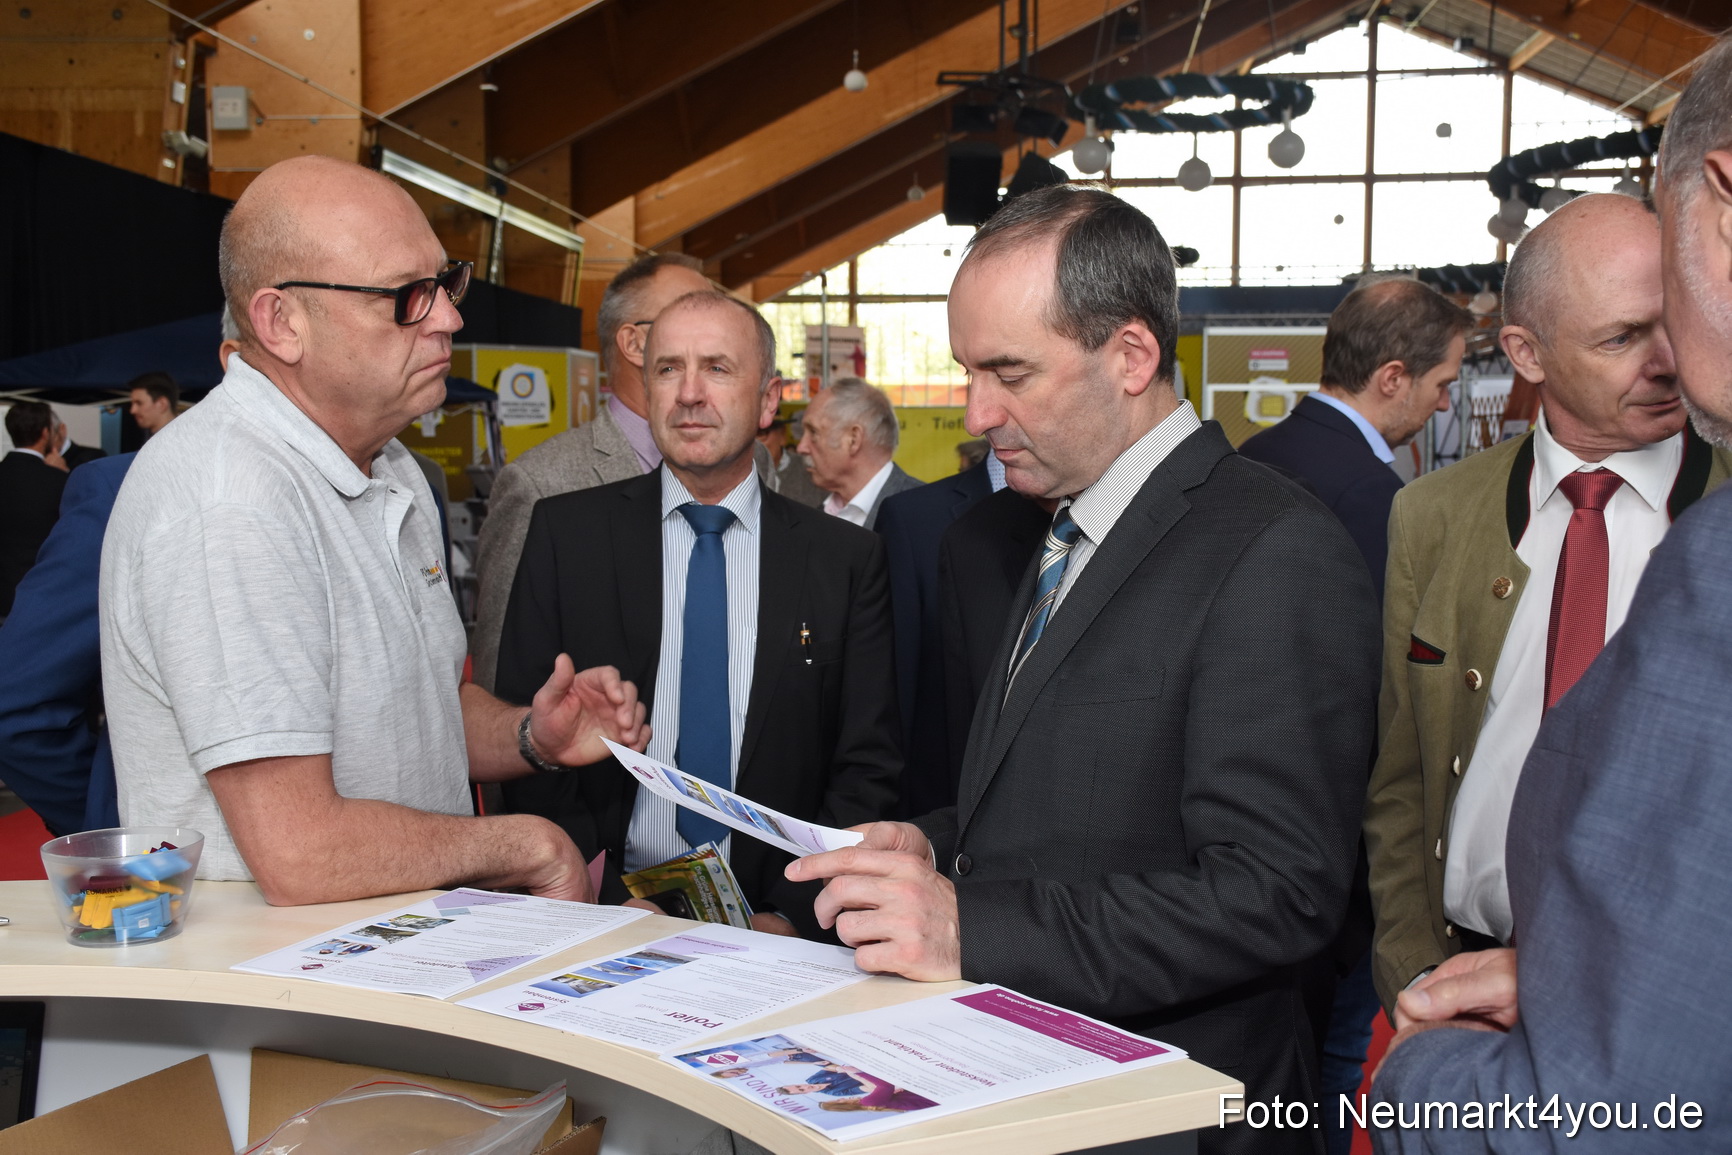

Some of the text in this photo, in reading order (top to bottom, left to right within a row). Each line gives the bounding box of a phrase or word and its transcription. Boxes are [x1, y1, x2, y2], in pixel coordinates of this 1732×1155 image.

[933, 416, 966, 430] Tief
[80, 886, 123, 895] NEUMARKT
[664, 1011, 724, 1029] Polier
[884, 1039, 932, 1061] Praktikant
[935, 1062, 997, 1087] Werkstudent
[746, 1080, 778, 1099] SIND
[773, 1098, 810, 1114] WIR
